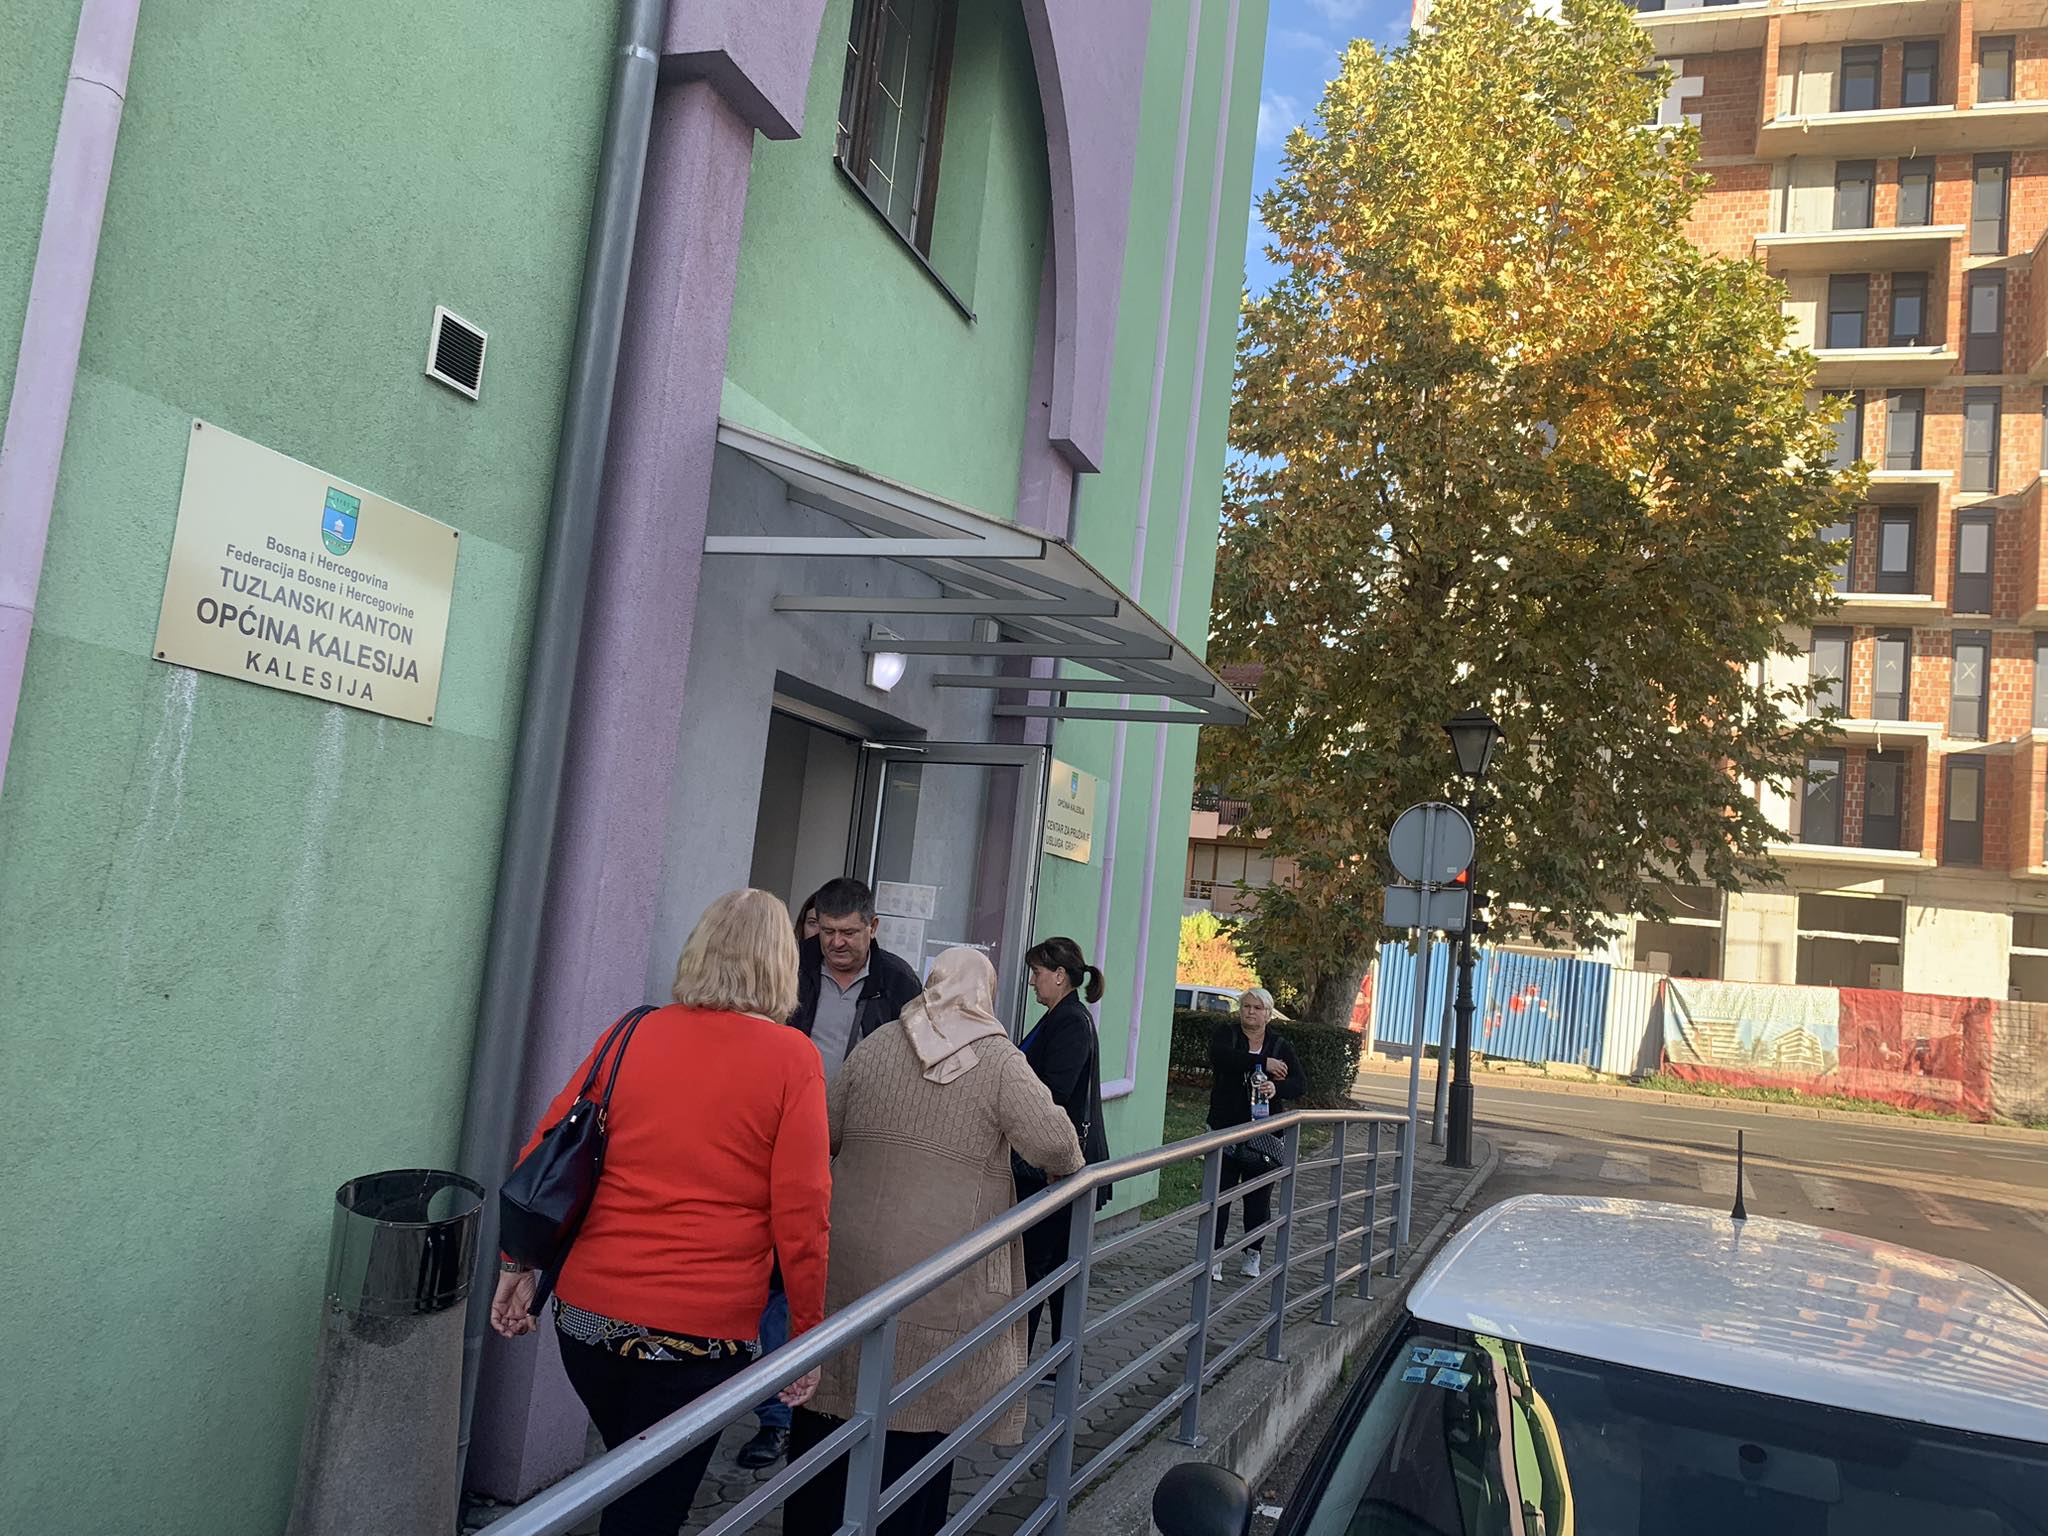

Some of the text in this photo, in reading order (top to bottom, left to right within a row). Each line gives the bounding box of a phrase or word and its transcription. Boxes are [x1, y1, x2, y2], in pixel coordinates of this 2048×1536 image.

[226, 543, 415, 619] Federacija Bosne i Hercegovine
[266, 536, 389, 592] Bosna i Hercegovina
[220, 566, 413, 646] TUZLANSKI KANTON
[196, 597, 419, 684] OPĆINA KALESIJA
[245, 650, 374, 702] KALESIJA
[1047, 820, 1063, 832] CENTAR
